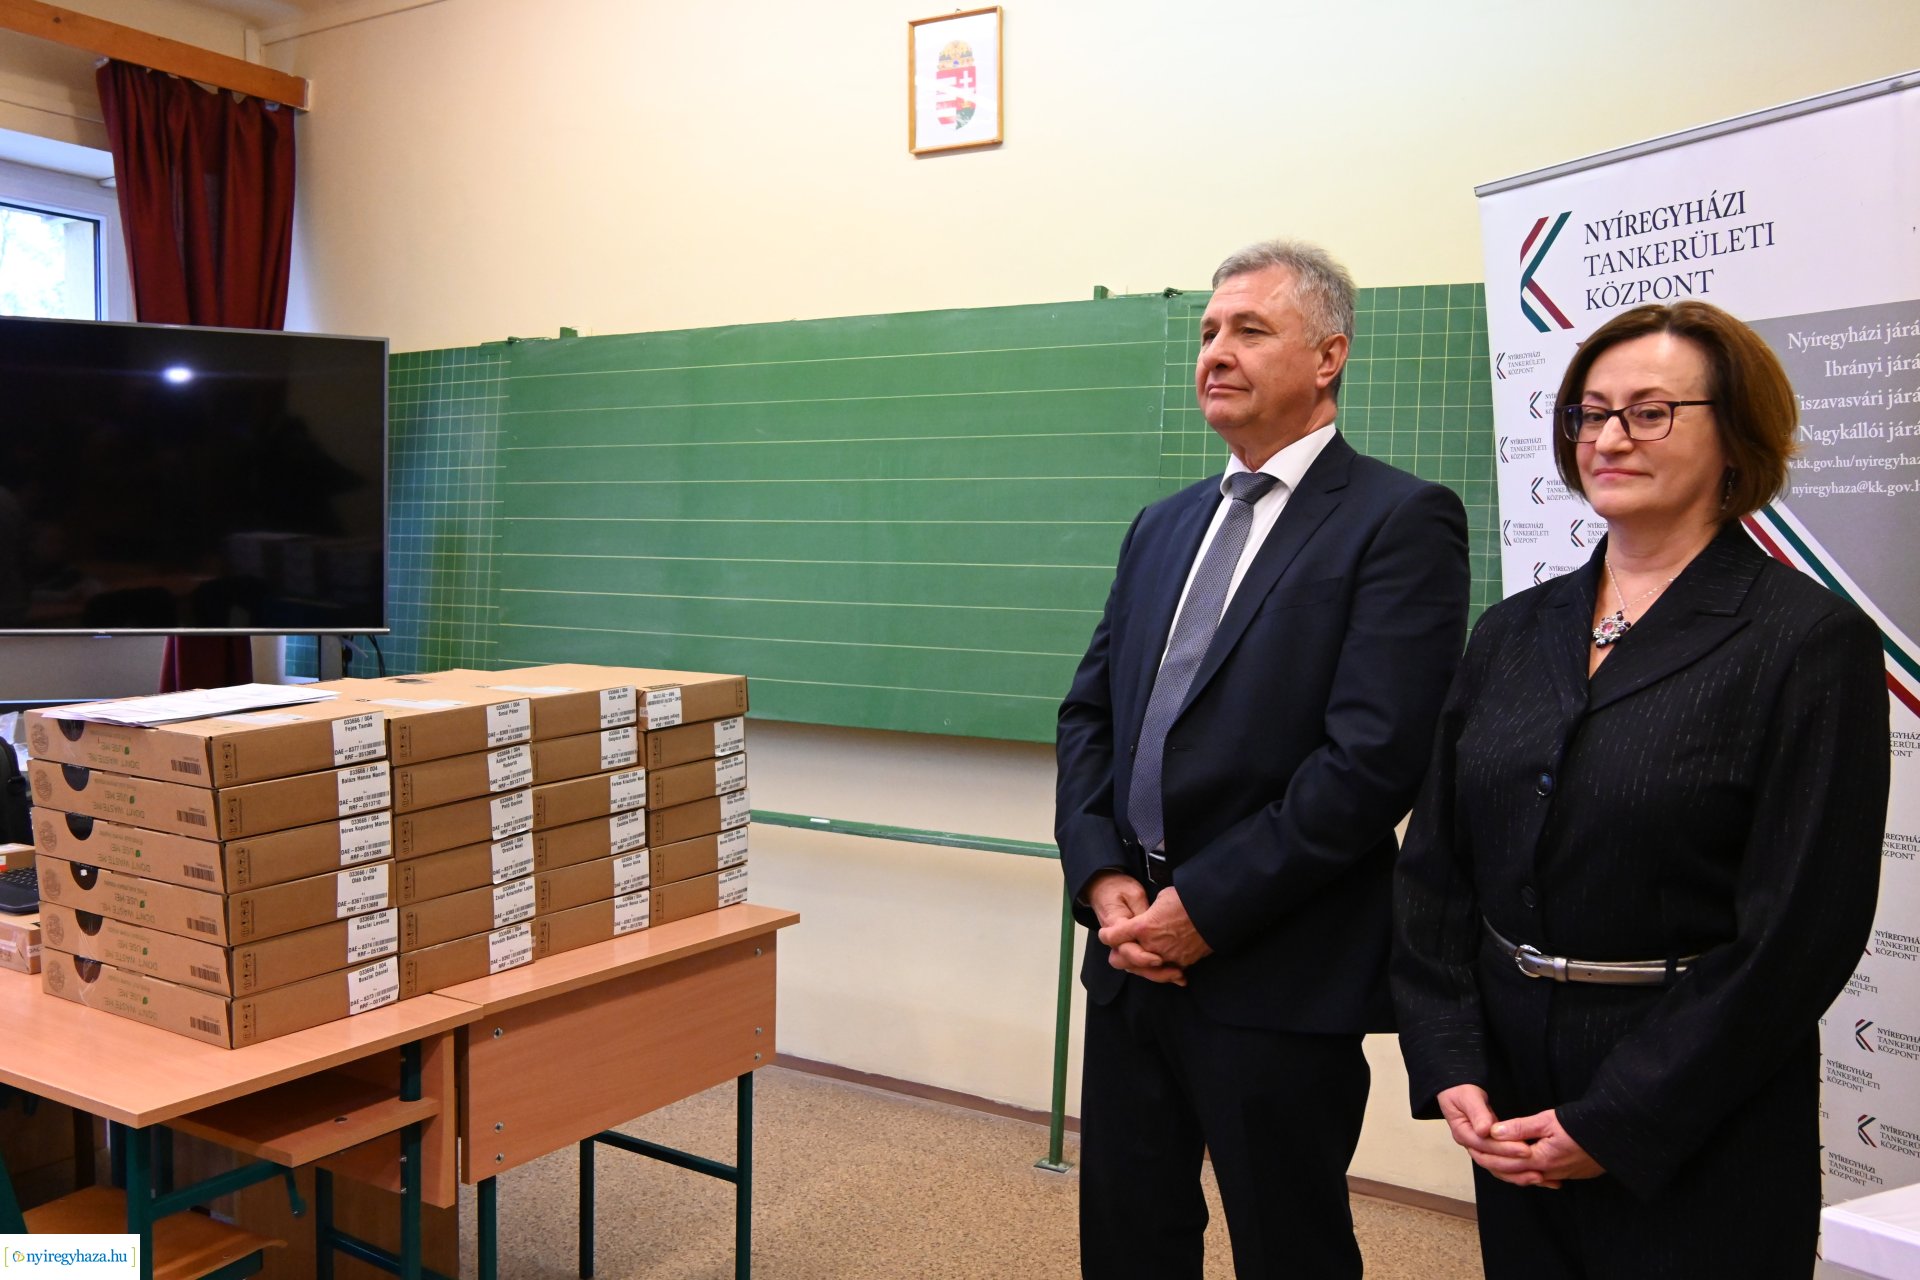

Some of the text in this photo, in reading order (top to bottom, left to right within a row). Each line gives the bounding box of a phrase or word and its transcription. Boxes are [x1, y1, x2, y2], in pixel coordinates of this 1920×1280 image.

[1584, 190, 1746, 244] NYÍREGYHÁZI
[1584, 222, 1776, 277] TANKERÜLETI
[1586, 268, 1714, 310] KÖZPONT
[1788, 324, 1881, 352] Nyíregyházi
[1825, 357, 1882, 378] Ibrányi
[1799, 422, 1883, 446] Nagykállói
